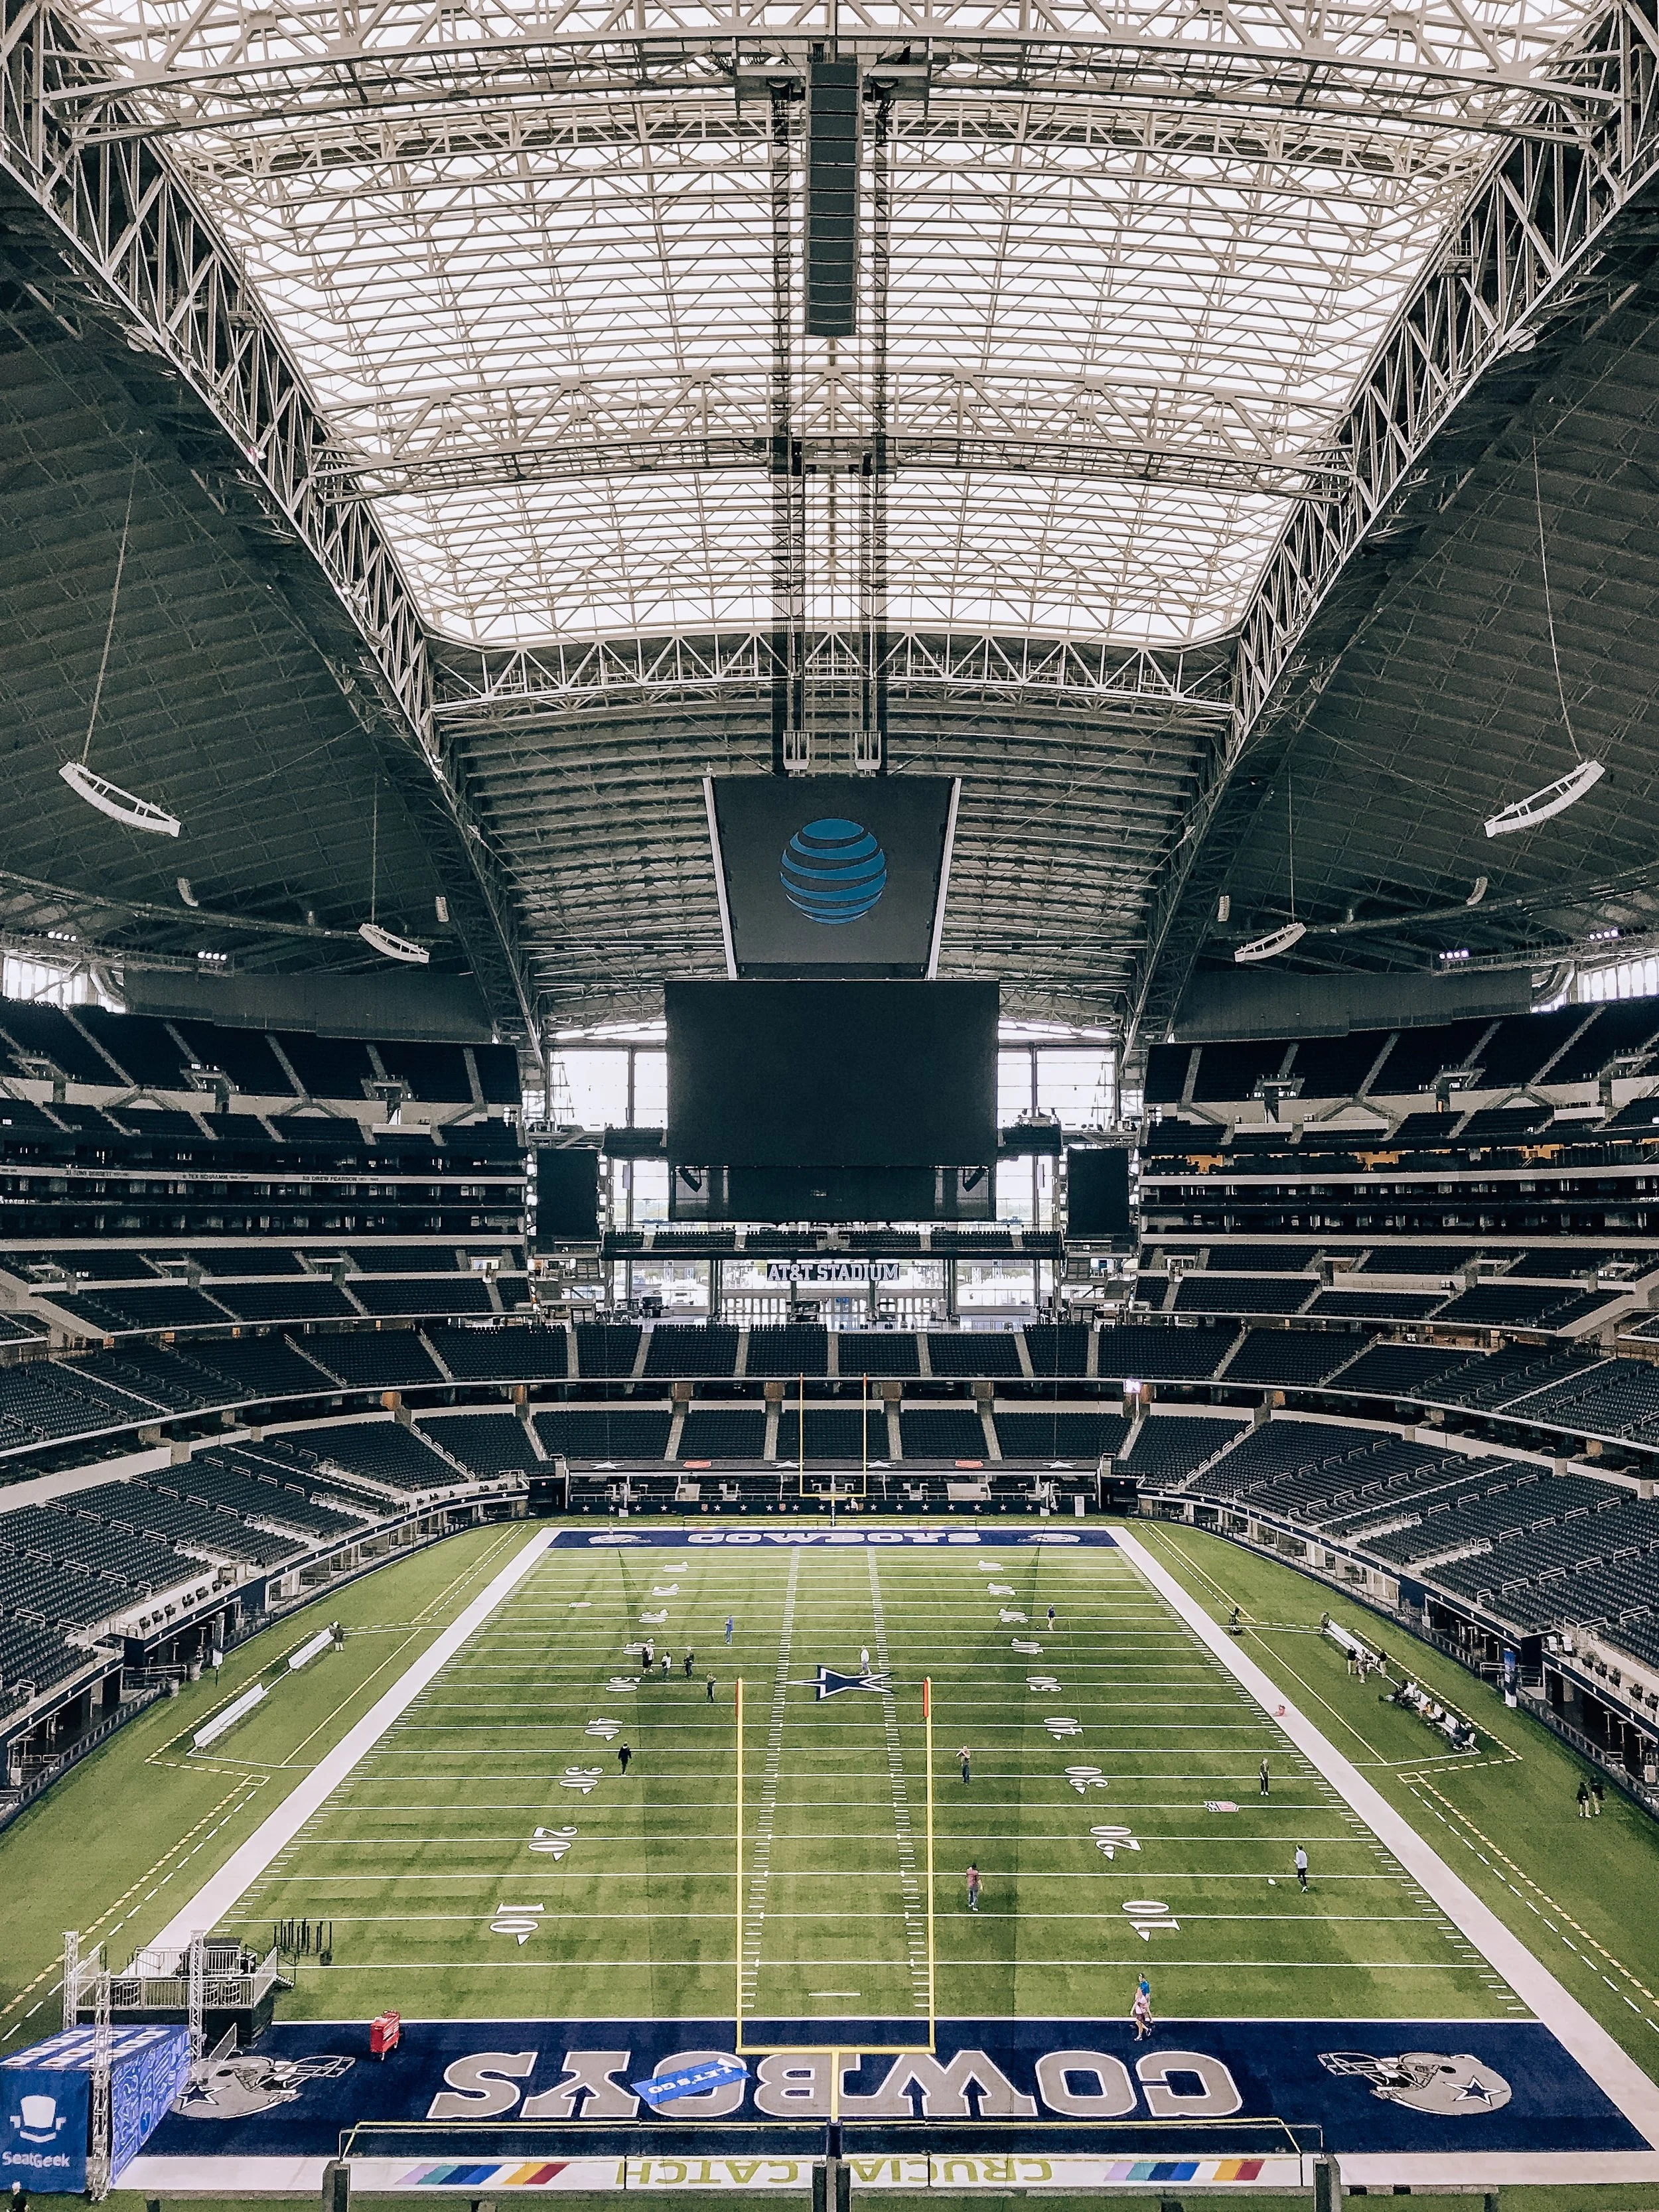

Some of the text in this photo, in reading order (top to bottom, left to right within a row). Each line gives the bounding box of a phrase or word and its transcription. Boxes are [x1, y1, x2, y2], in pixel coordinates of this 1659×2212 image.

[767, 1264, 899, 1281] AT&T STADIUM
[687, 1533, 981, 1544] COWBOYS
[559, 1766, 604, 1788] 30
[1064, 1765, 1109, 1788] 30
[528, 1826, 579, 1852] 20
[1090, 1825, 1142, 1851] 20
[490, 1902, 546, 1933] 10
[1121, 1900, 1182, 1931] 10
[426, 2050, 1243, 2119] COWBOYS
[647, 2066, 733, 2095] LET'S GO
[2, 2150, 70, 2168] SeatGeek
[615, 2158, 1054, 2184] CRUCIA CATCH
